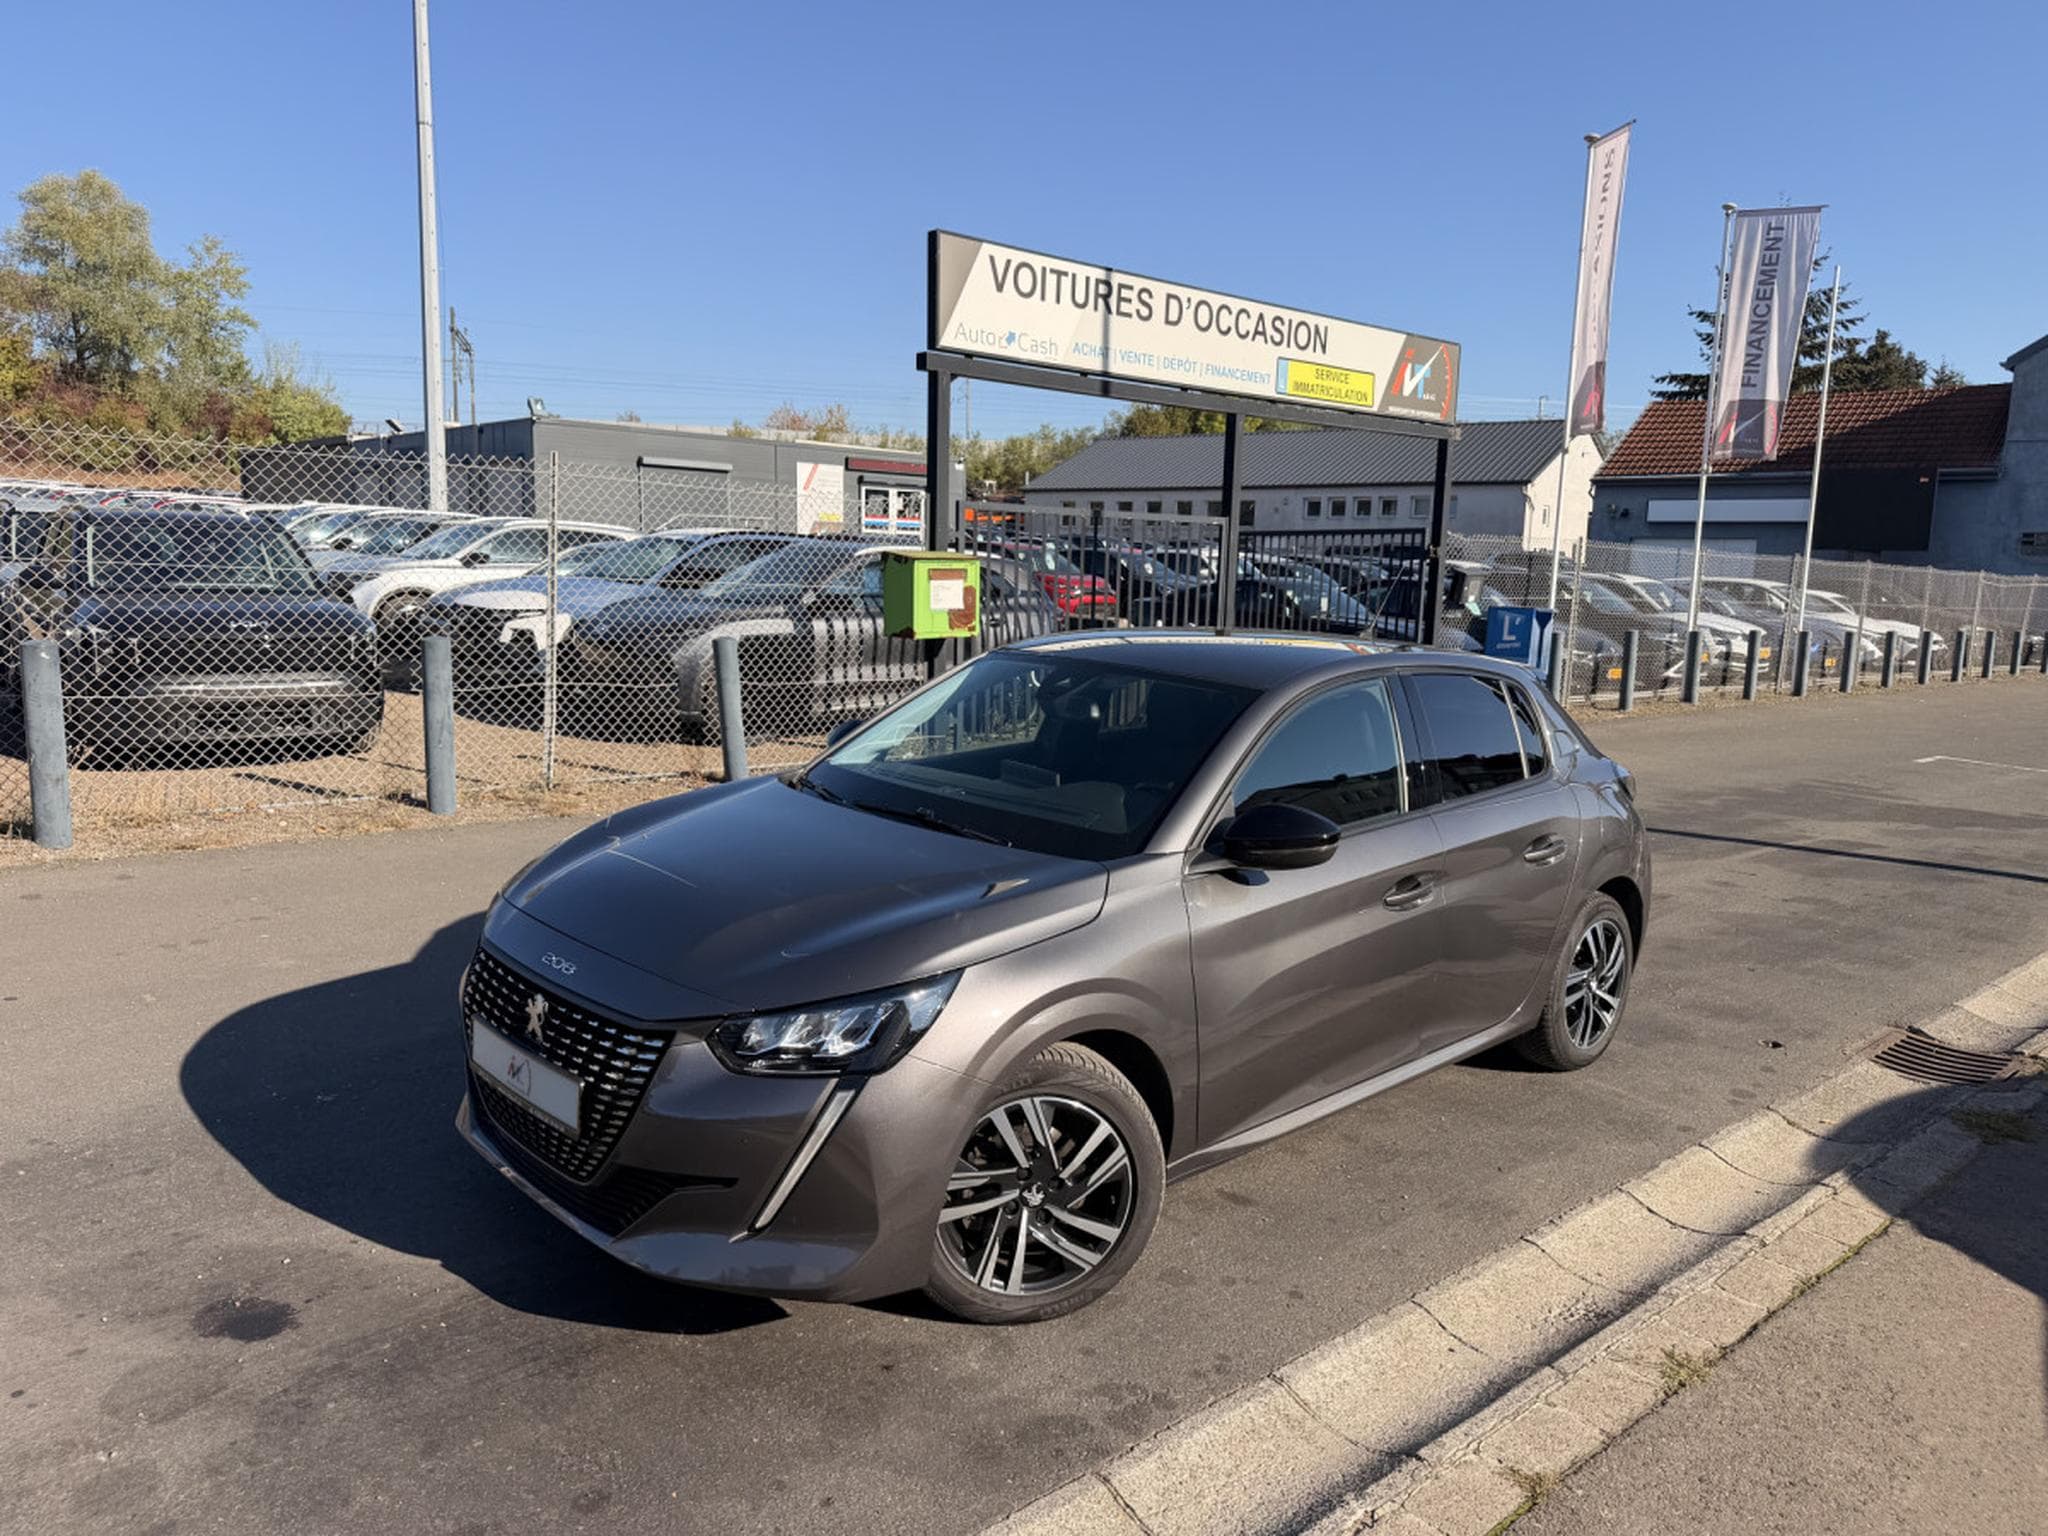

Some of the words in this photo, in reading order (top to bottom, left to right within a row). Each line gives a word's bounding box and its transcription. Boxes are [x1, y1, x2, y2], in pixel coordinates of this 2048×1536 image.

[988, 254, 1154, 322] VOITURES
[1164, 292, 1329, 355] D'OCCASION
[1741, 221, 1785, 388] FINANCEMENT
[1119, 349, 1154, 367] VENTE
[1205, 363, 1271, 385] FINANCEMENT
[1314, 368, 1350, 386] SERVICE
[1292, 380, 1369, 403] IMMATRICULATION
[541, 951, 577, 976] 208
